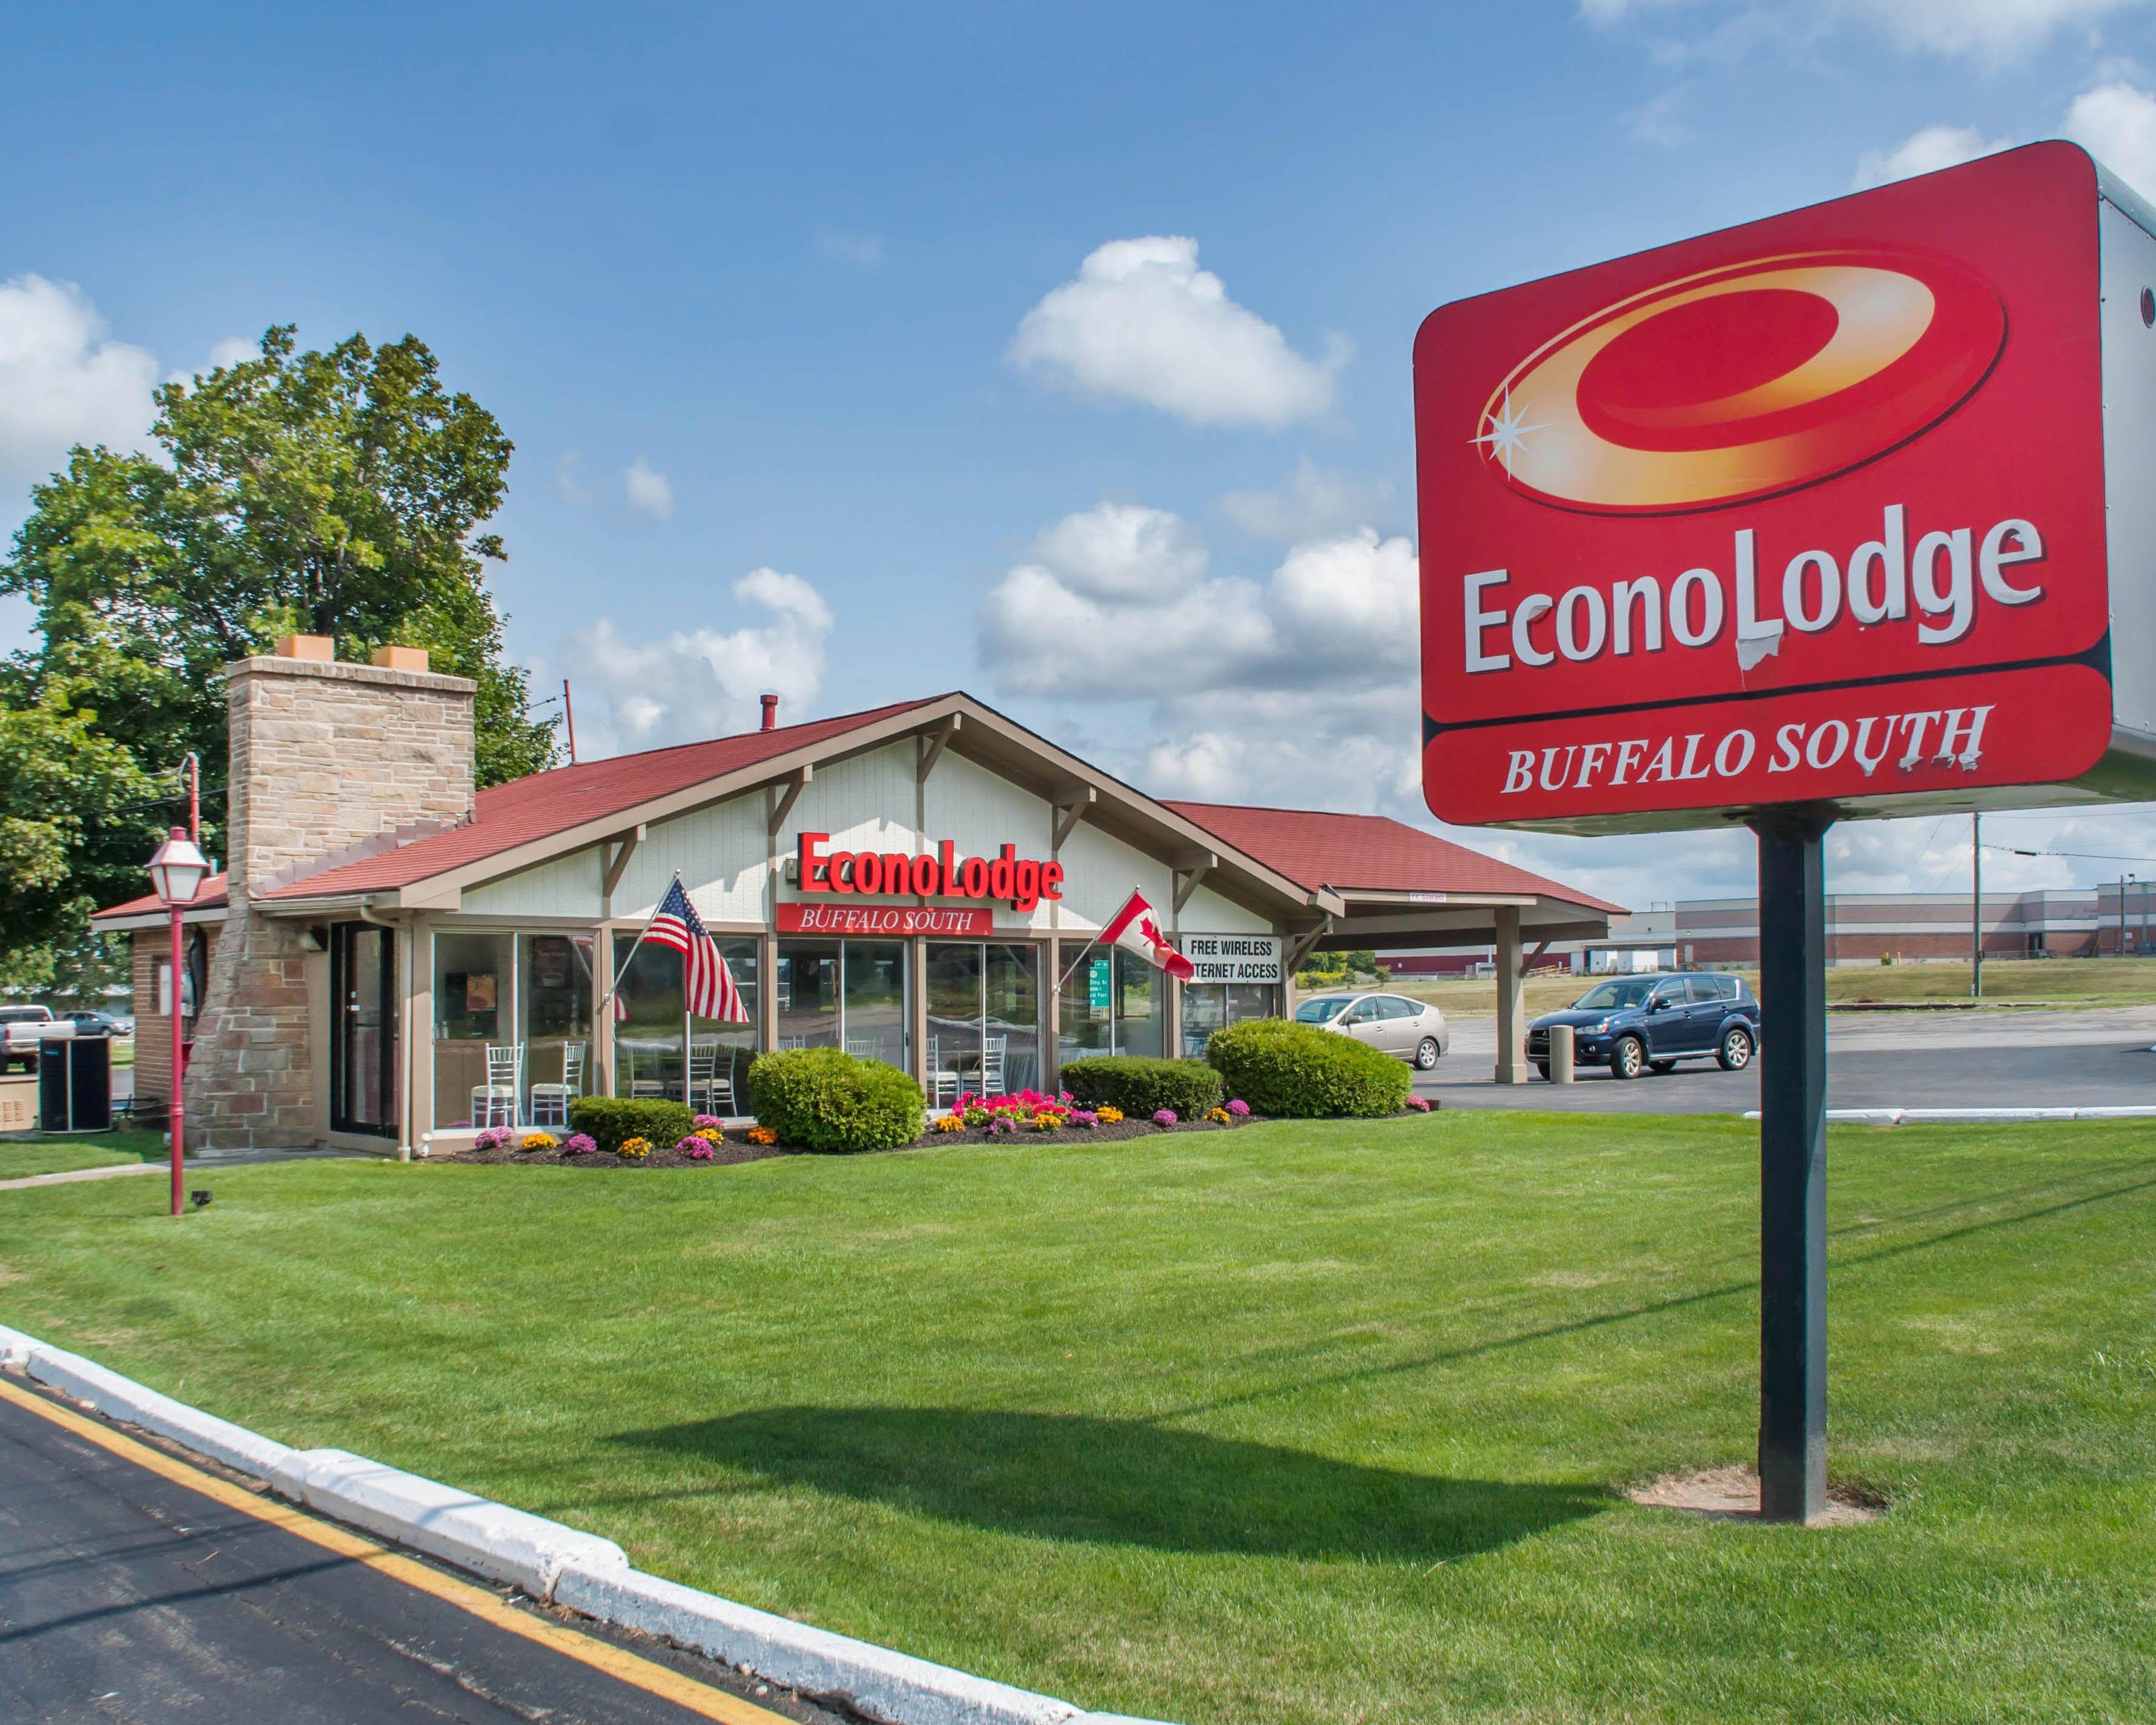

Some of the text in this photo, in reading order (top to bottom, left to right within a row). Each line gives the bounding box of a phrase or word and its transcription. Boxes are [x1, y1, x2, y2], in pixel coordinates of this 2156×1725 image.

[1464, 503, 2043, 674] EconoLodge
[1500, 703, 1996, 794] BUFFALO SOUTH
[797, 832, 1064, 912] EconoLodge
[800, 909, 973, 931] BUFFALO SOUTH
[1191, 939, 1272, 956] FREE WIRELESS
[1192, 963, 1278, 978] TERNET ACCESS
